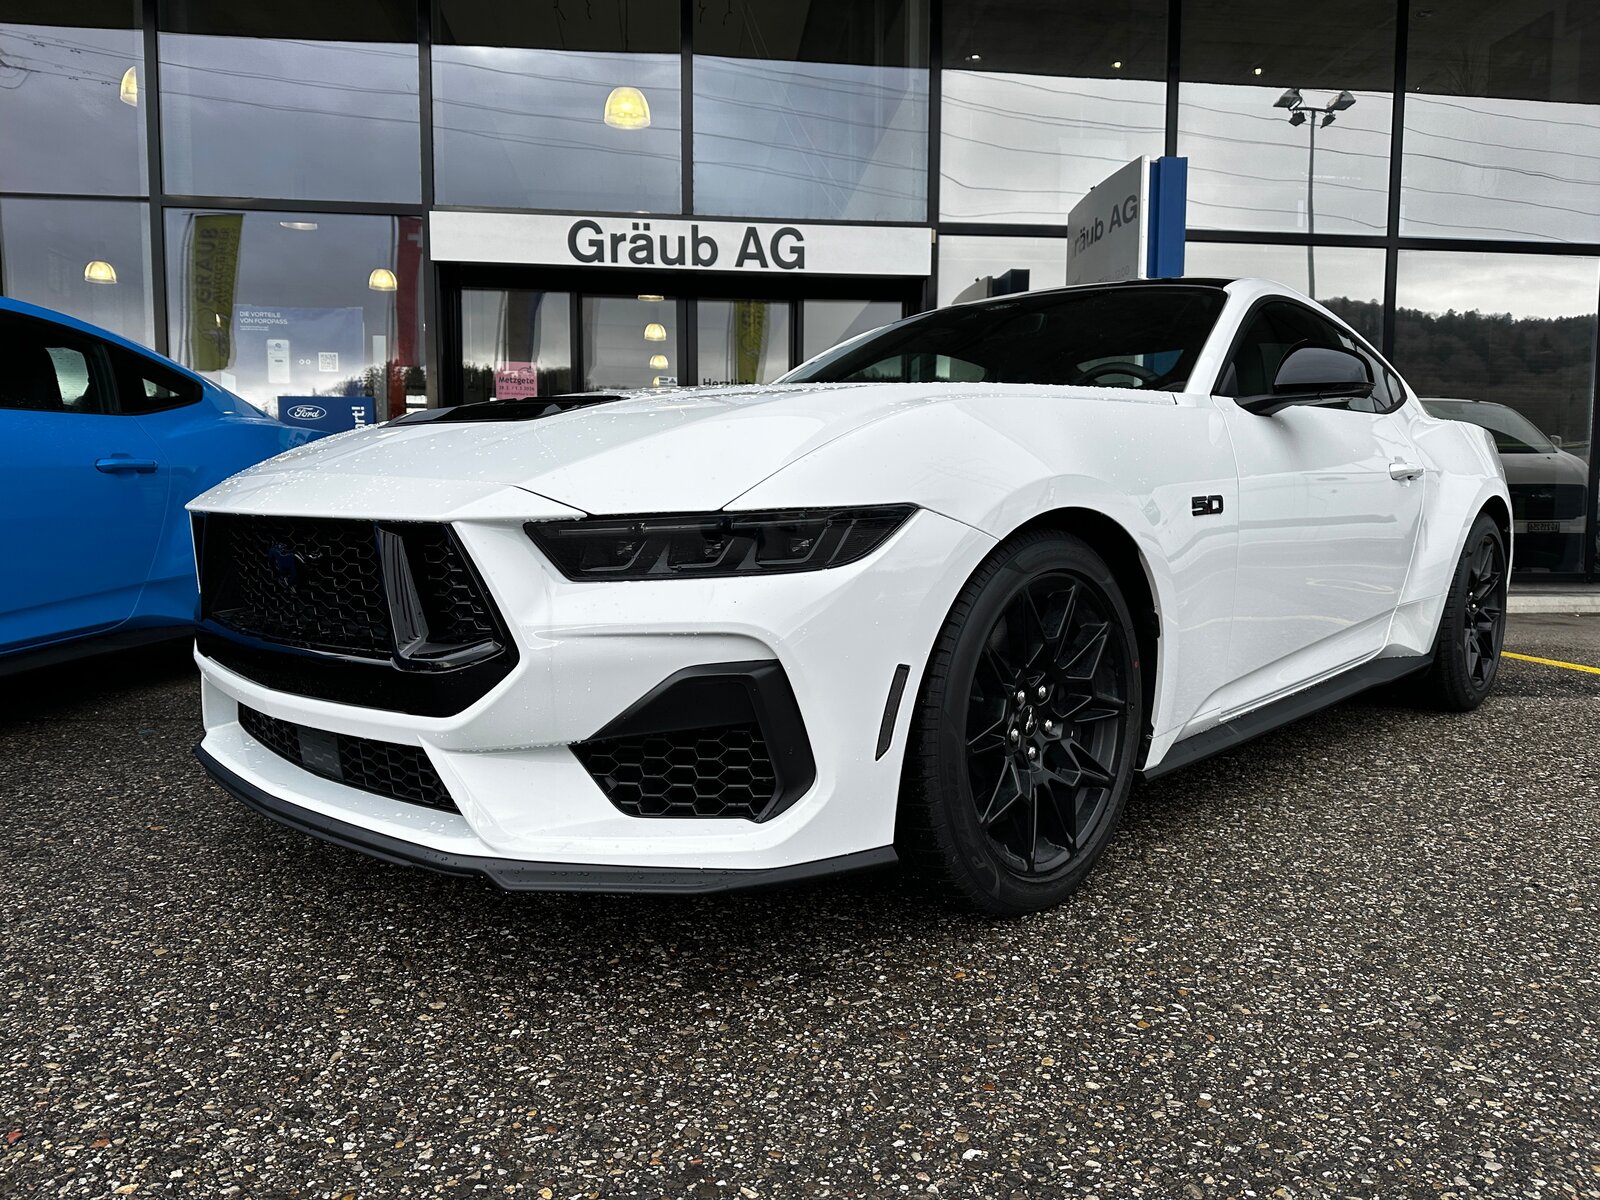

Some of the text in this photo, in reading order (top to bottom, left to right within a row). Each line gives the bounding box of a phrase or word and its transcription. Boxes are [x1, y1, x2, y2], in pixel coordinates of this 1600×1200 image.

[567, 219, 806, 270] Gräub AG
[1073, 194, 1138, 257] räub AG
[294, 407, 320, 418] Ford
